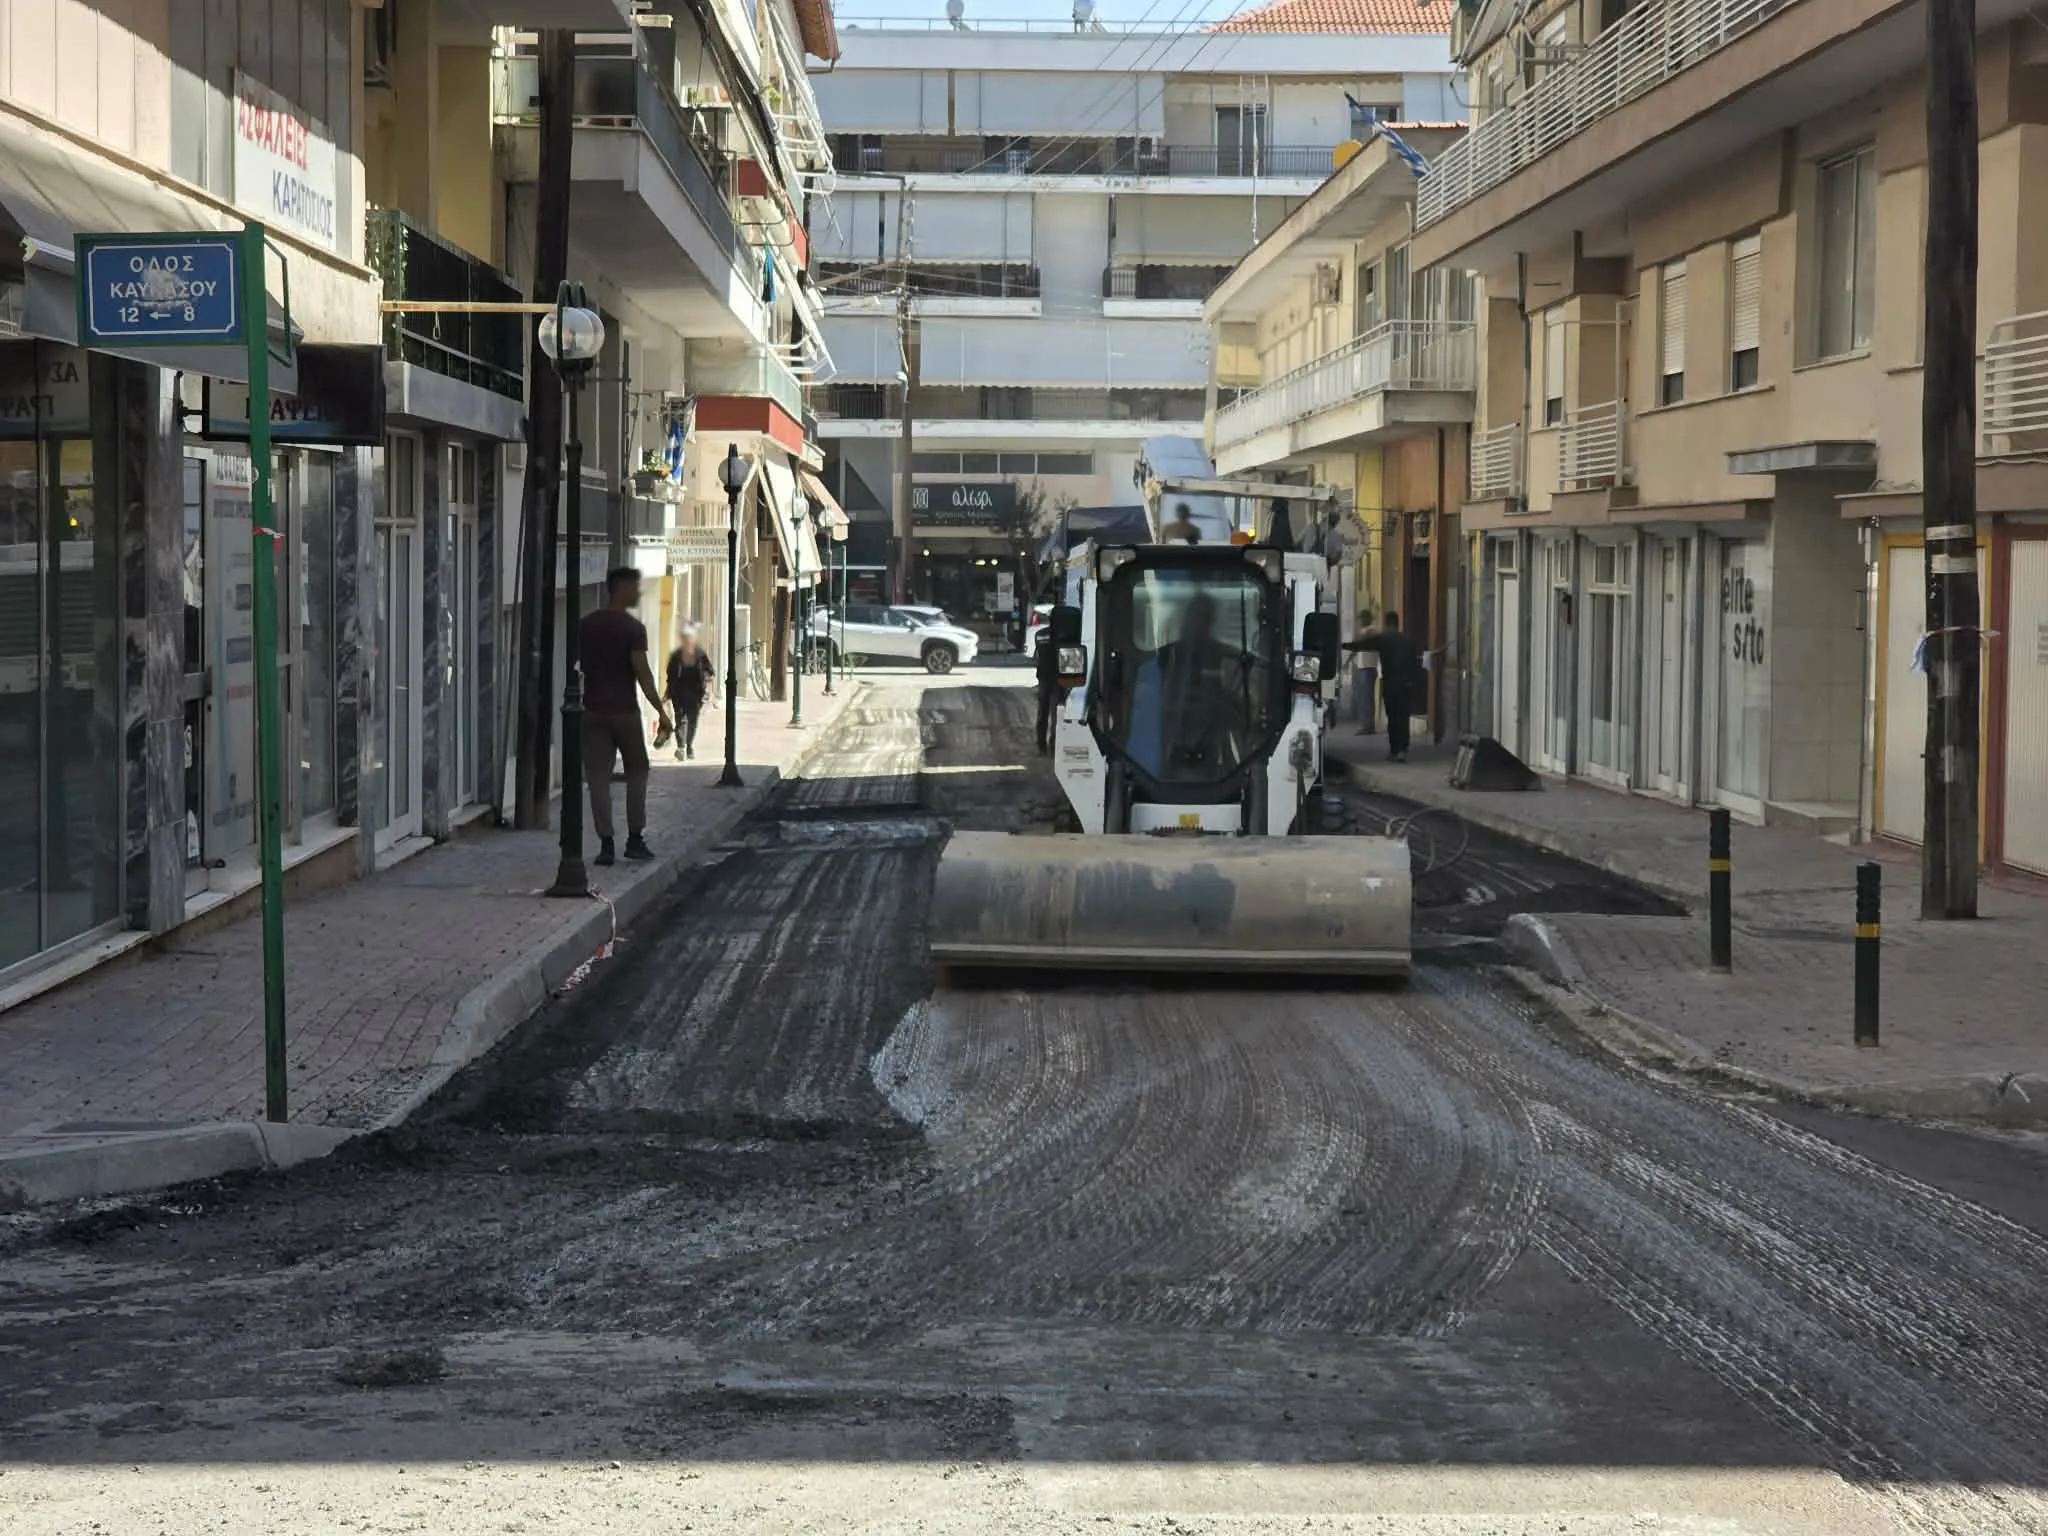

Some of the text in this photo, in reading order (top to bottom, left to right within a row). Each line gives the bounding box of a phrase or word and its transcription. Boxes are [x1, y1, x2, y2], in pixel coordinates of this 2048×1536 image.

[239, 96, 309, 170] ΑΣΦΑΛΕΙΕΣ
[129, 255, 194, 273] ΟΔΟΣ
[110, 281, 217, 299] ΚΑΥΑΣΟΥ
[119, 306, 195, 323] 12 8
[952, 484, 993, 510] αλεύρι
[1722, 567, 1755, 614] elite
